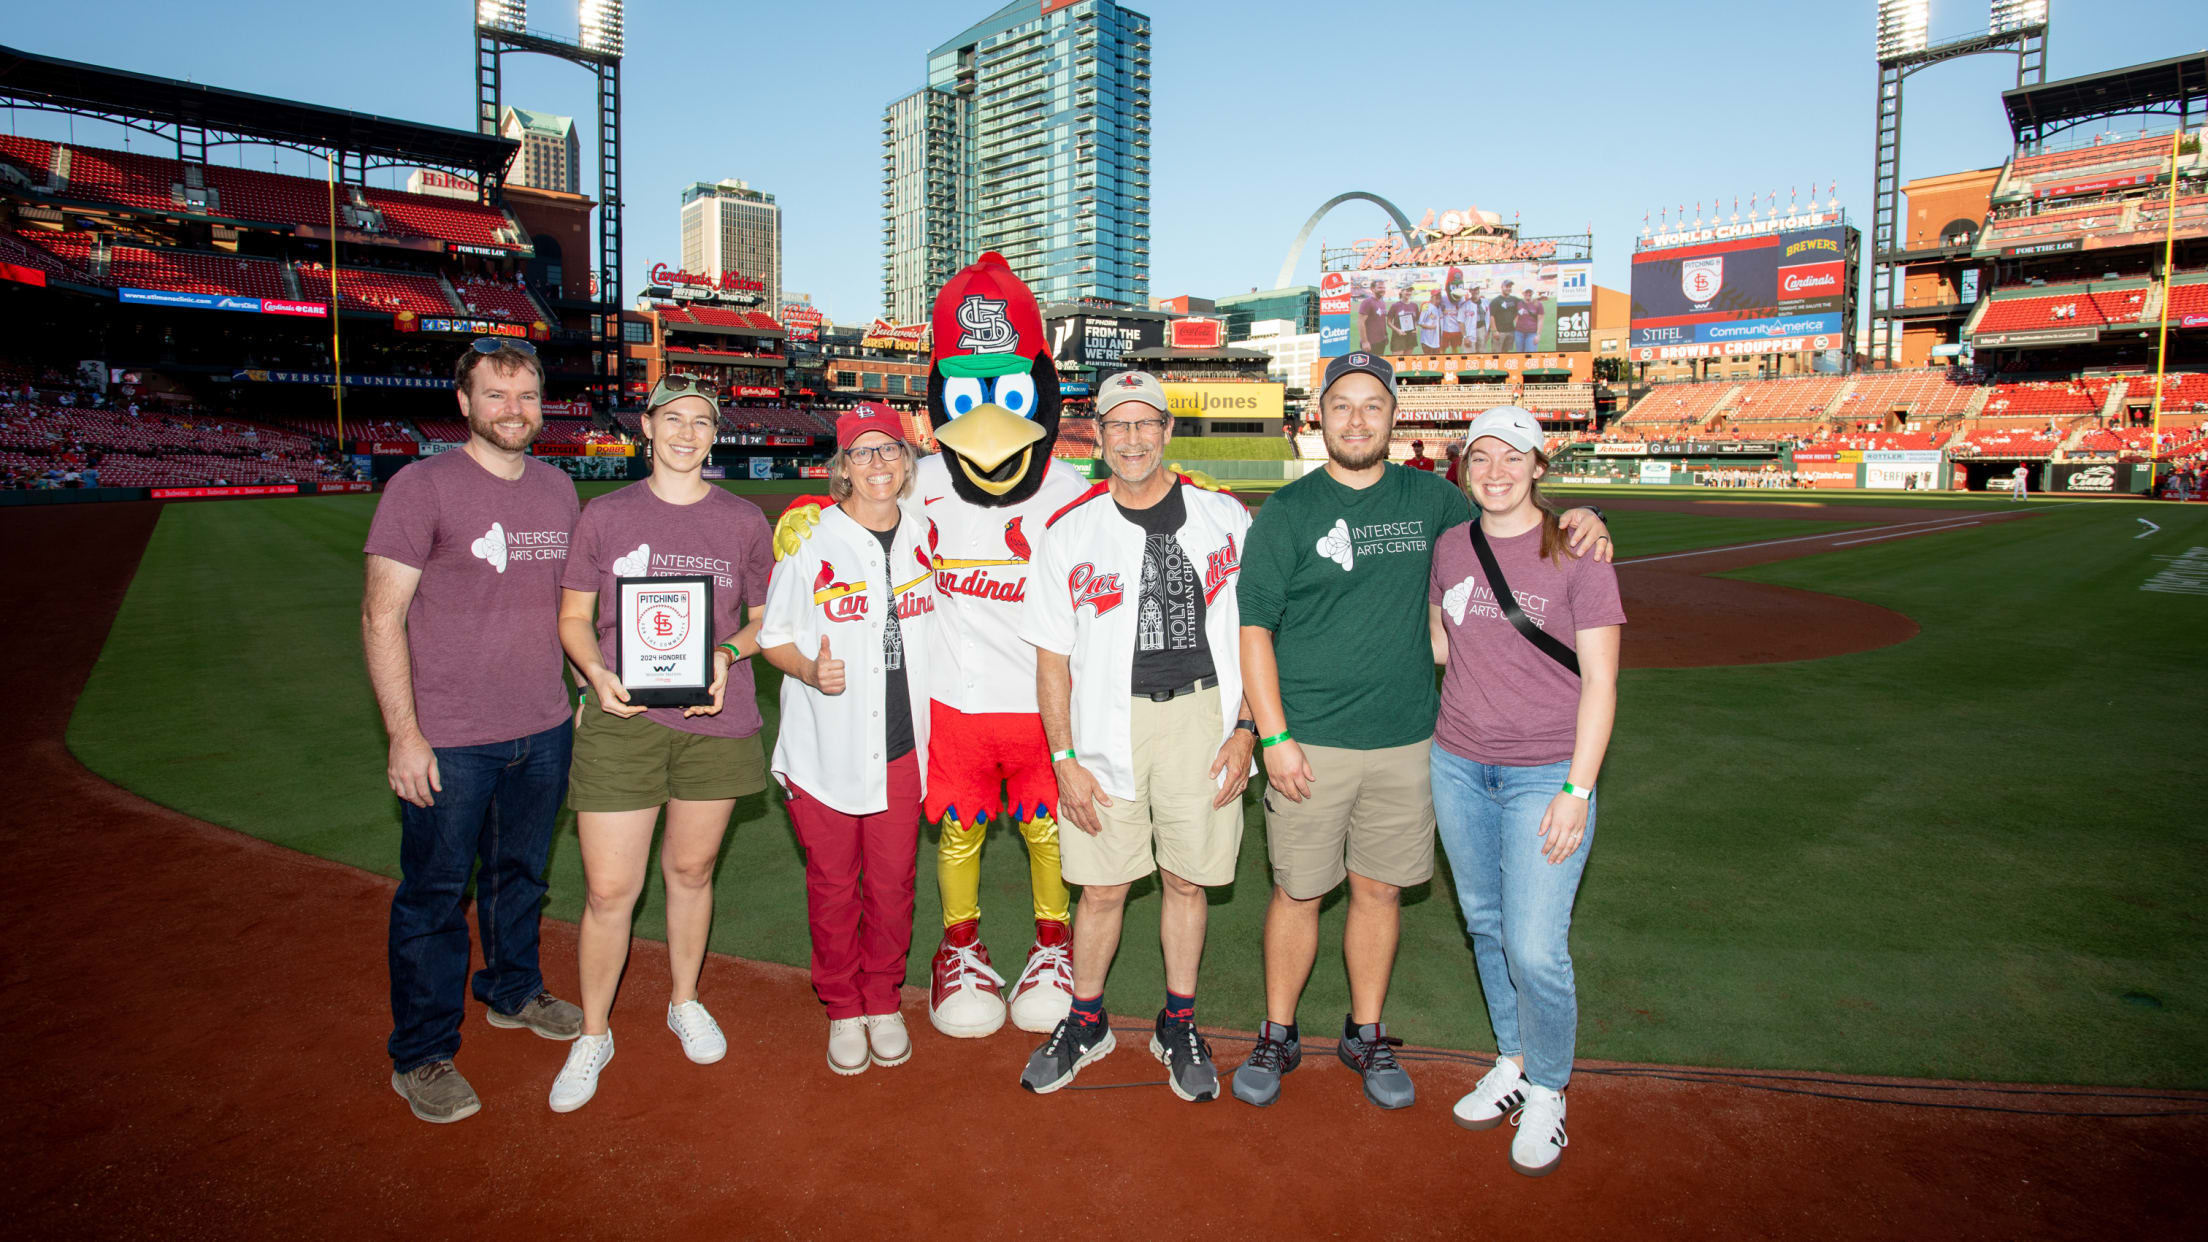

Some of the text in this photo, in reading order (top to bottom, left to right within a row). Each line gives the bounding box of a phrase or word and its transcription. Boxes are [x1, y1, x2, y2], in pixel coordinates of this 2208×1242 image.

[1654, 215, 1824, 246] WORLD CHAMPIONS
[457, 245, 474, 254] FOR
[475, 246, 490, 255] THE
[1352, 232, 1558, 270] Budweiser
[1786, 239, 1837, 257] BREWERS
[2015, 247, 2034, 255] FOR
[2035, 245, 2055, 253] THE
[651, 262, 763, 292] Cardinals Nation
[1784, 274, 1835, 291] Cardinals
[302, 306, 325, 315] CARE
[422, 319, 526, 337] BIG MAC LAND
[1558, 311, 1589, 330] stl
[1085, 326, 1141, 340] FROM THE
[1642, 327, 1683, 342] STIFEL
[863, 338, 893, 349] BREW
[1085, 337, 1133, 350] LOU AND
[1660, 345, 1709, 358] BROWN
[1712, 346, 1721, 355] &
[1725, 339, 1804, 354] CROUPPEN
[1085, 348, 1120, 360] WE'RE
[1168, 392, 1257, 411] ard Jones
[1416, 411, 1462, 420] STADIUM
[1600, 445, 1643, 453] Schnucks
[2068, 472, 2114, 487] Club
[507, 532, 568, 544] INTERSECT
[1352, 521, 1423, 539] INTERSECT
[510, 549, 567, 560] ARTS CENTE
[1357, 541, 1427, 556] ARTS CENTER
[652, 553, 731, 572] INTERSECT
[1165, 534, 1183, 595] CROSS
[934, 570, 1026, 603] Cardinal
[1068, 562, 1124, 612] Car
[640, 595, 679, 603] PITCHING
[1473, 586, 1549, 612] INTSECT
[824, 596, 868, 623] Car
[1185, 585, 1196, 648] LUTHERAN
[1469, 605, 1545, 630] ARTS CER
[1169, 600, 1187, 650] HOLY
